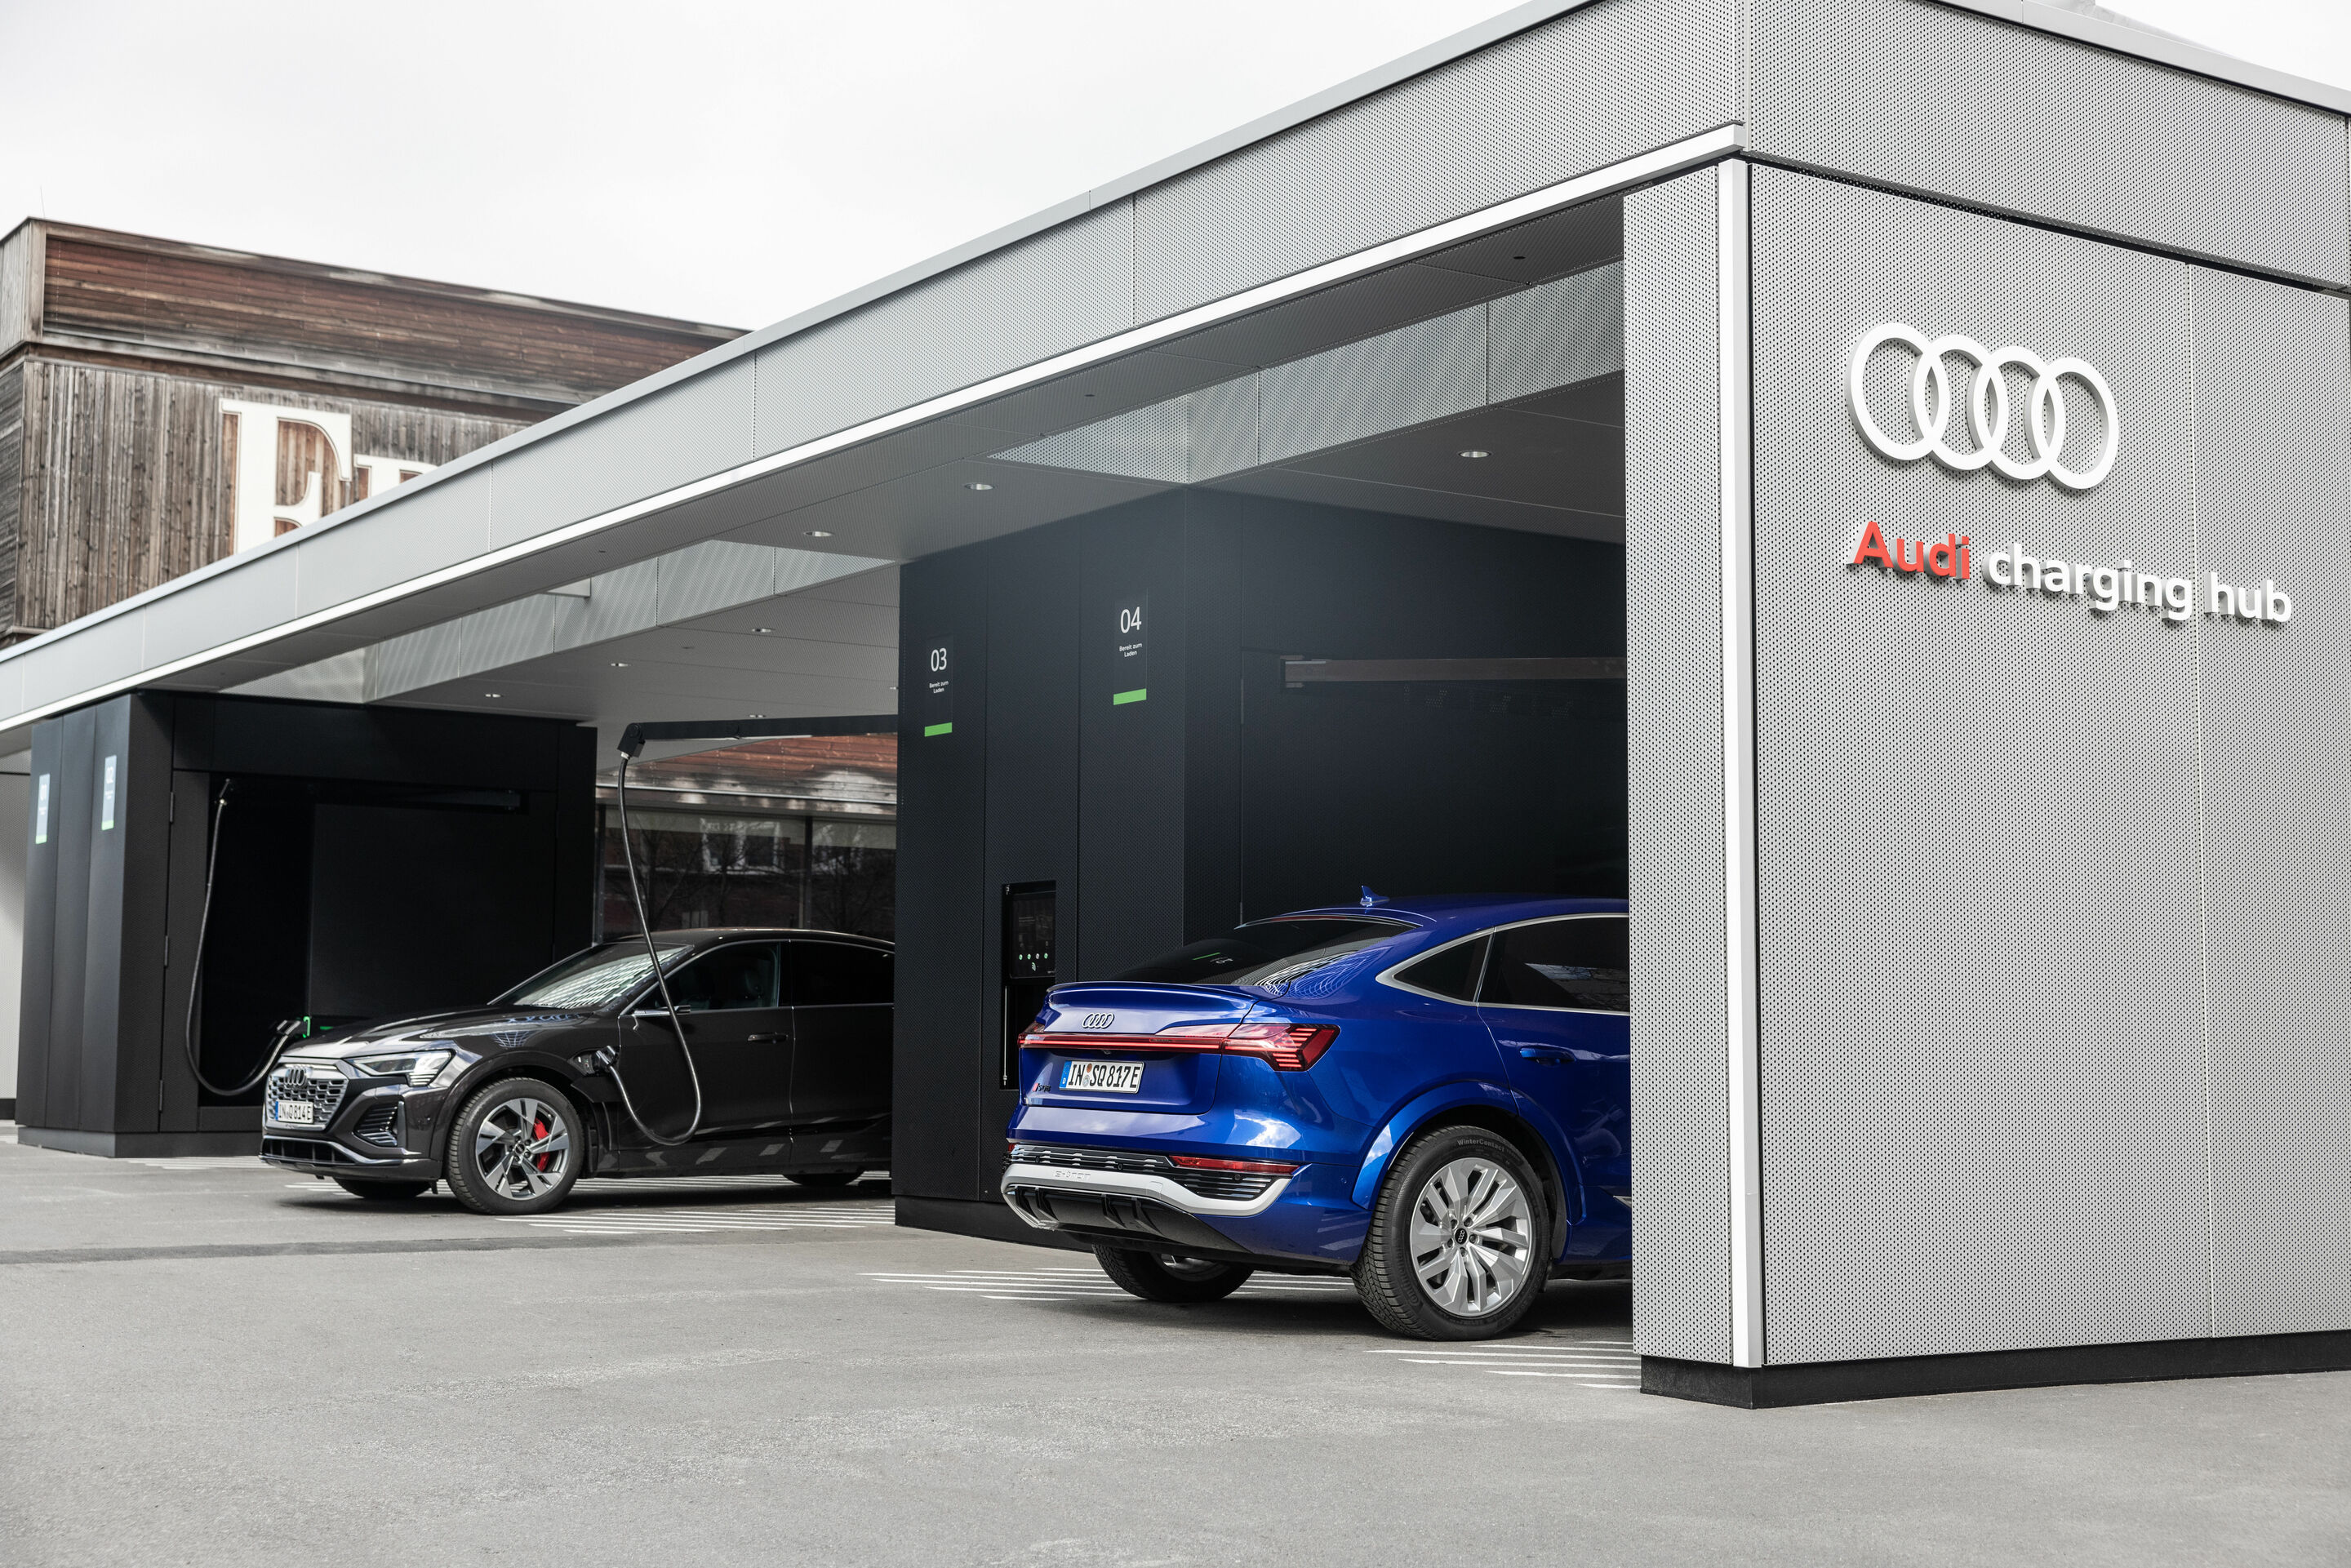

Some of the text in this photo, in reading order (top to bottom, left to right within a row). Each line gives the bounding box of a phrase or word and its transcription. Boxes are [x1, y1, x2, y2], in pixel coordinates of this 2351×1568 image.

[1847, 521, 2292, 623] Audi charging hub
[1120, 606, 1142, 633] 04
[931, 647, 947, 672] 03
[1457, 1138, 1505, 1153] WinterContact
